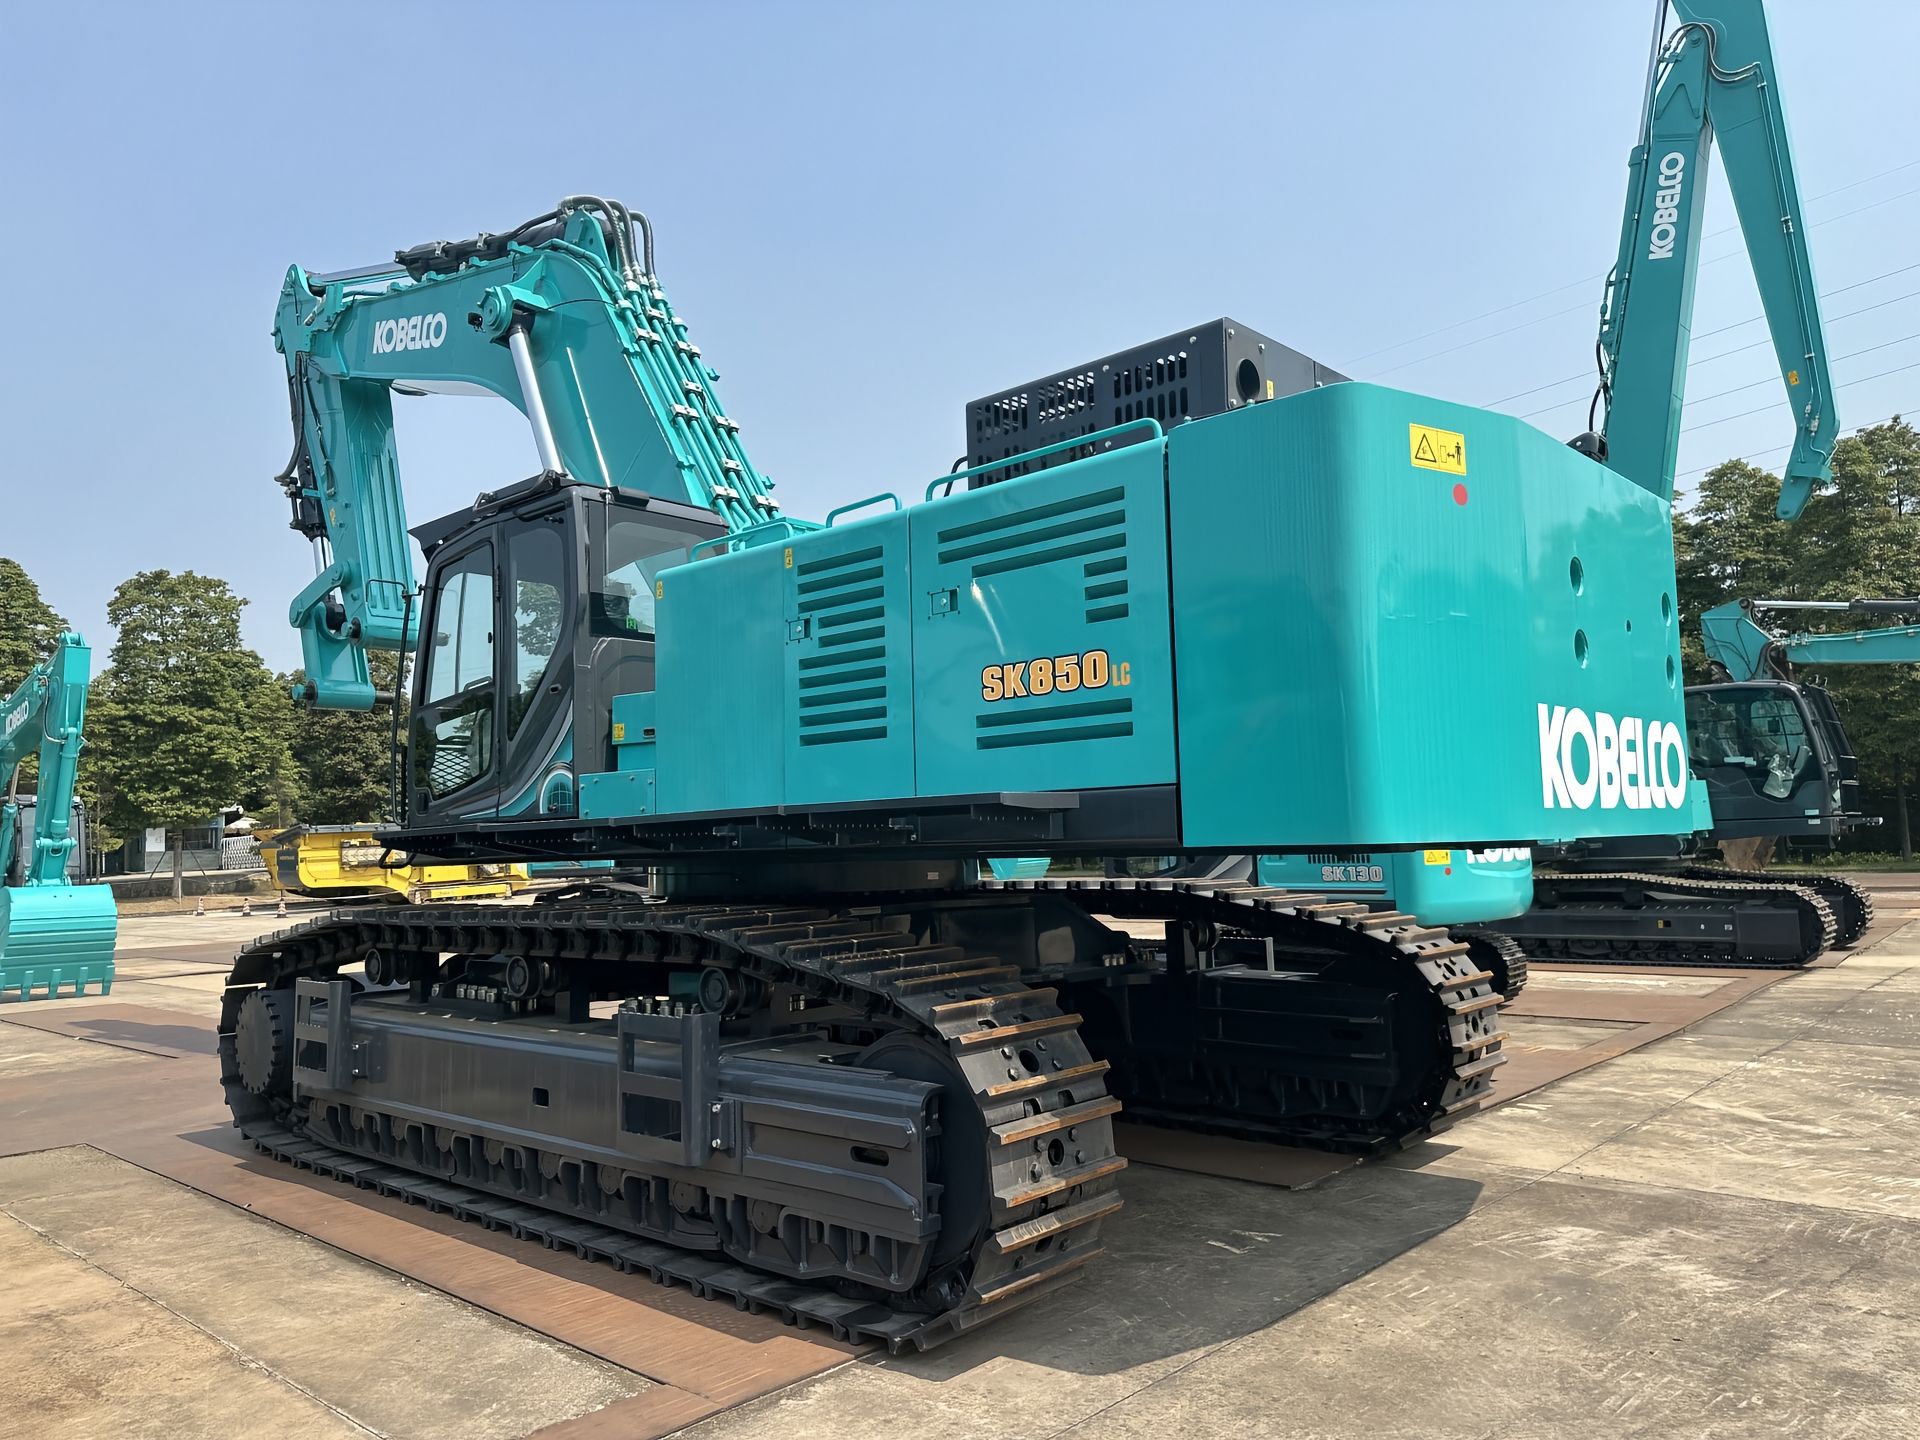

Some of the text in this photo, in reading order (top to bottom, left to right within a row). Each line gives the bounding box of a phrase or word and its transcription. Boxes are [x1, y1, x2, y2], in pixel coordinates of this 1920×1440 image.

[1648, 152, 1685, 260] KOBELCO
[373, 312, 447, 354] KOBELCO
[1537, 703, 1687, 810] KOBELCO
[1321, 866, 1383, 882] SK130
